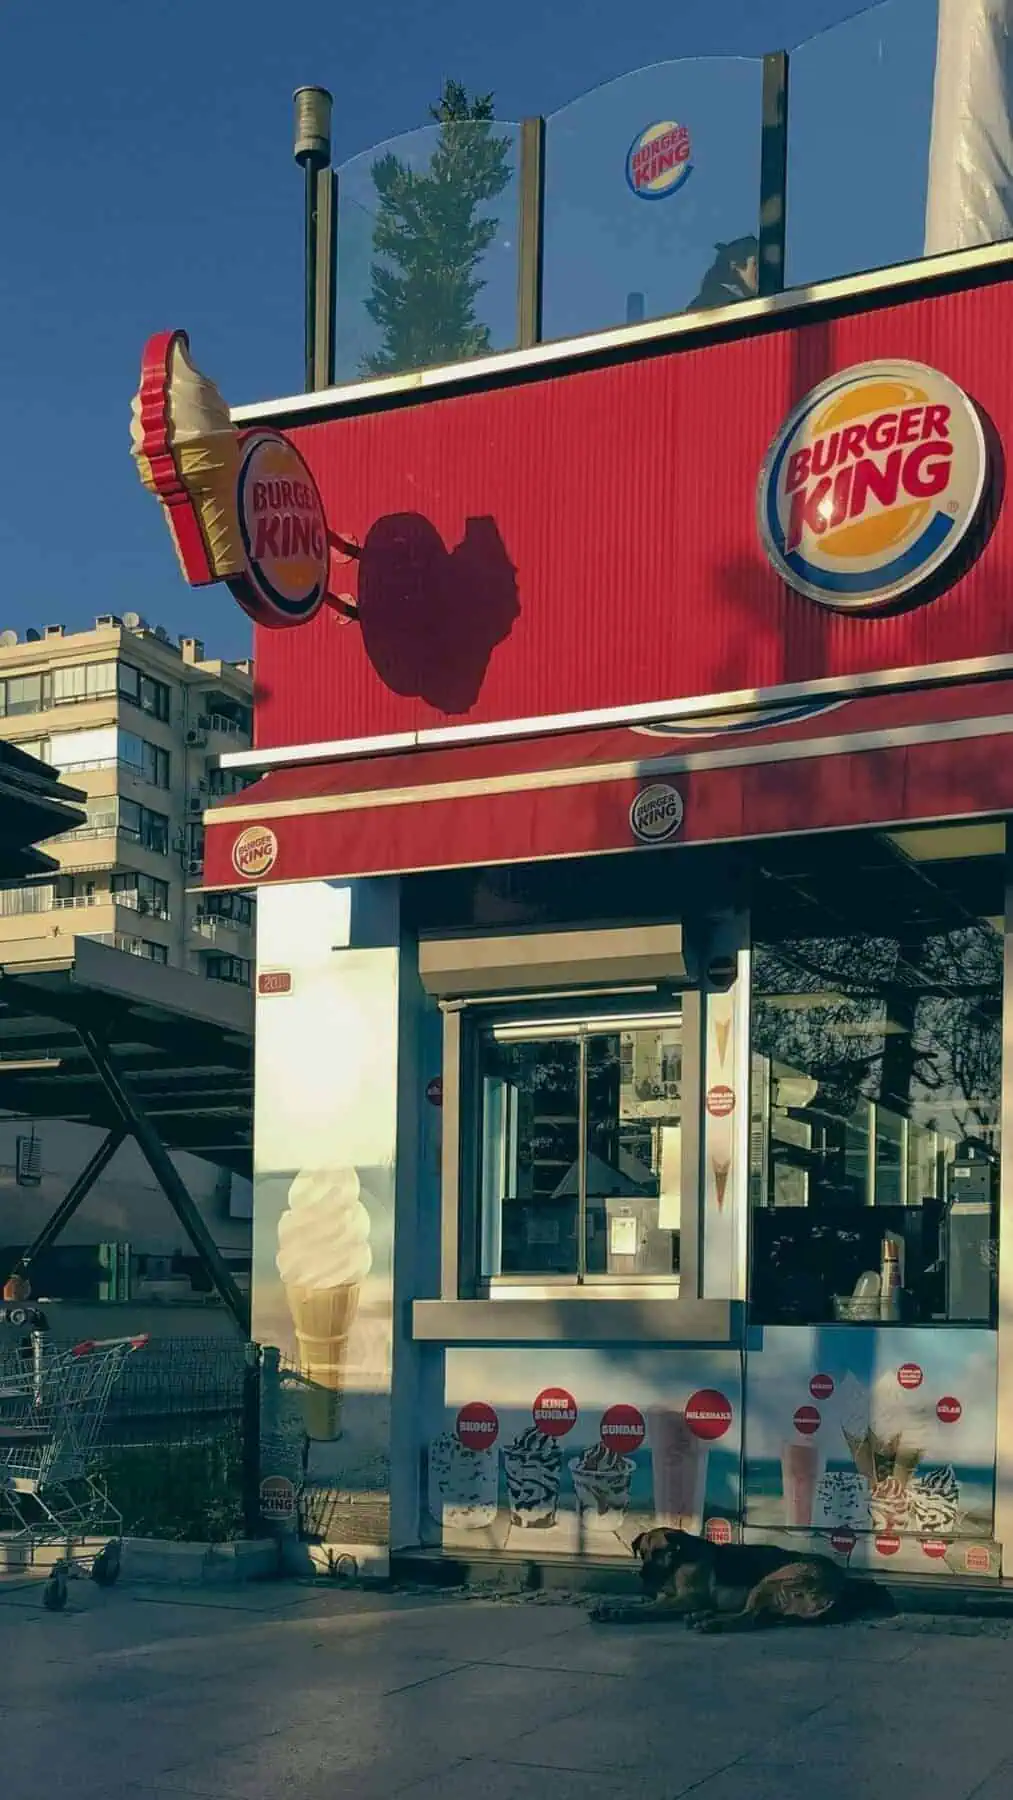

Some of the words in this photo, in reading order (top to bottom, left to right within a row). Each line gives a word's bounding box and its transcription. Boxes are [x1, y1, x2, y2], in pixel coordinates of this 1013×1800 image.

[632, 127, 689, 170] BURGER
[634, 141, 690, 188] KING
[785, 404, 951, 495] BURGER
[788, 440, 954, 551] KING
[255, 516, 323, 560] KING
[637, 794, 674, 817] BURGER
[638, 803, 677, 828] KING
[240, 844, 273, 868] KING
[534, 1409, 577, 1420] SUNDAE
[541, 1399, 569, 1409] KING
[686, 1411, 732, 1420] MILKSHAKE
[601, 1425, 644, 1436] SUNDAE
[260, 1497, 296, 1511] KING
